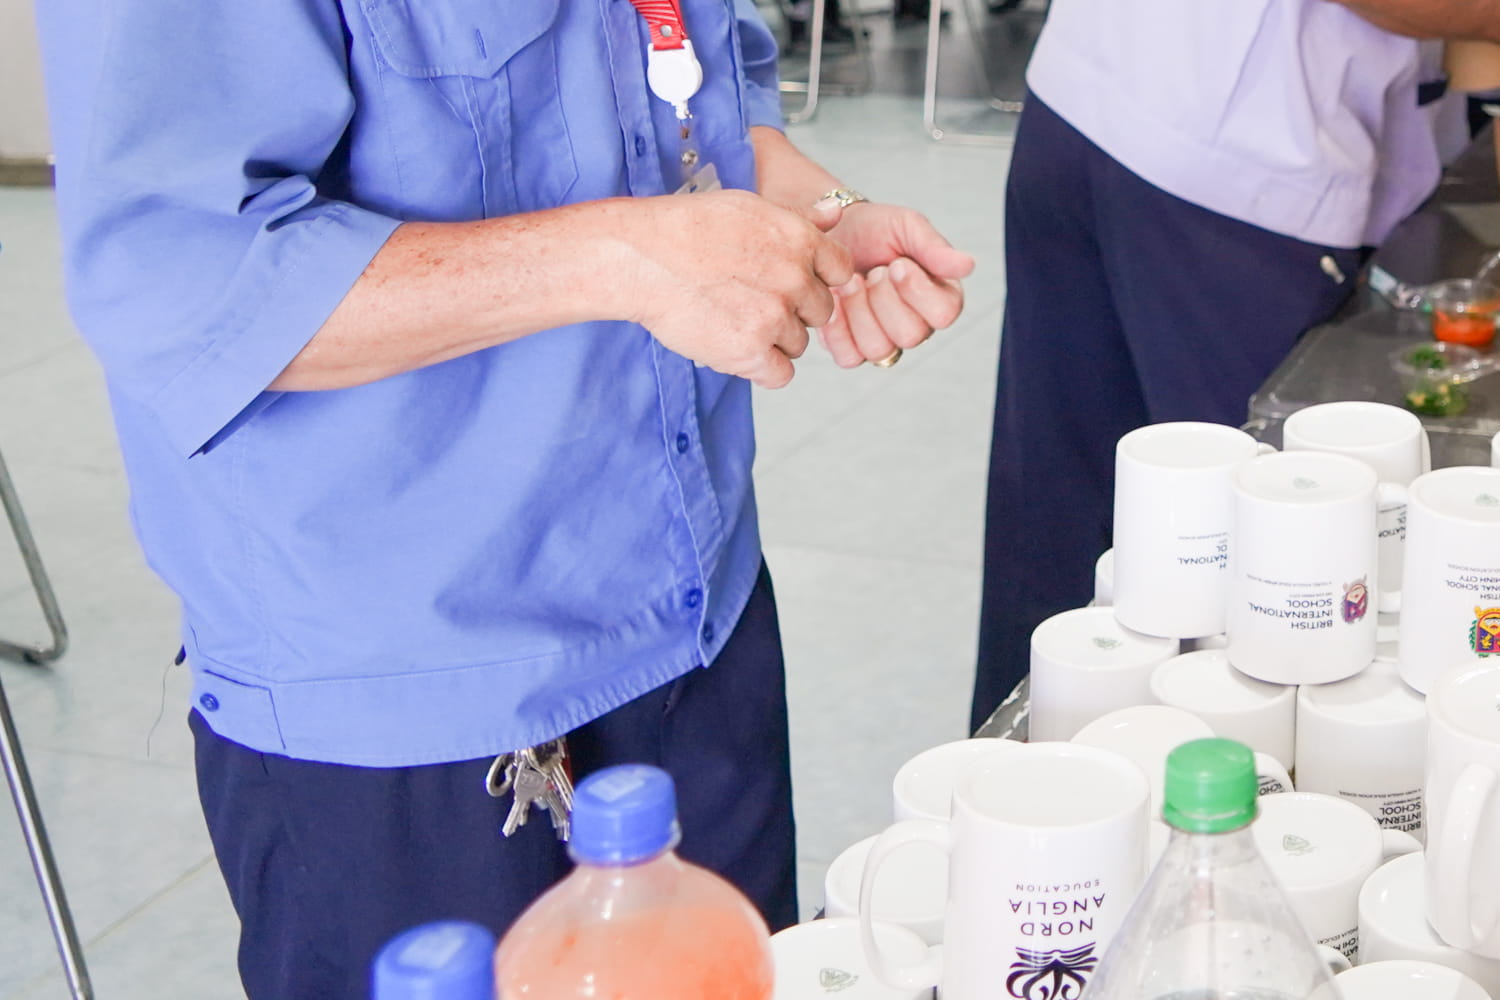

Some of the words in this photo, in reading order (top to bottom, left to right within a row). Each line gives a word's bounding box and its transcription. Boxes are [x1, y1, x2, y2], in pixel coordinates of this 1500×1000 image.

[1446, 579, 1479, 591] SCHOOL
[1459, 575, 1479, 583] CITY
[1248, 602, 1334, 619] INTERNATIONAL
[1286, 598, 1333, 609] SCHOOL
[1291, 619, 1334, 630] BRITISH
[1379, 801, 1422, 815] SCHOOL
[1015, 879, 1101, 893] EDUCATION
[1008, 893, 1106, 916] ANGLIA
[1020, 917, 1094, 937] NORD
